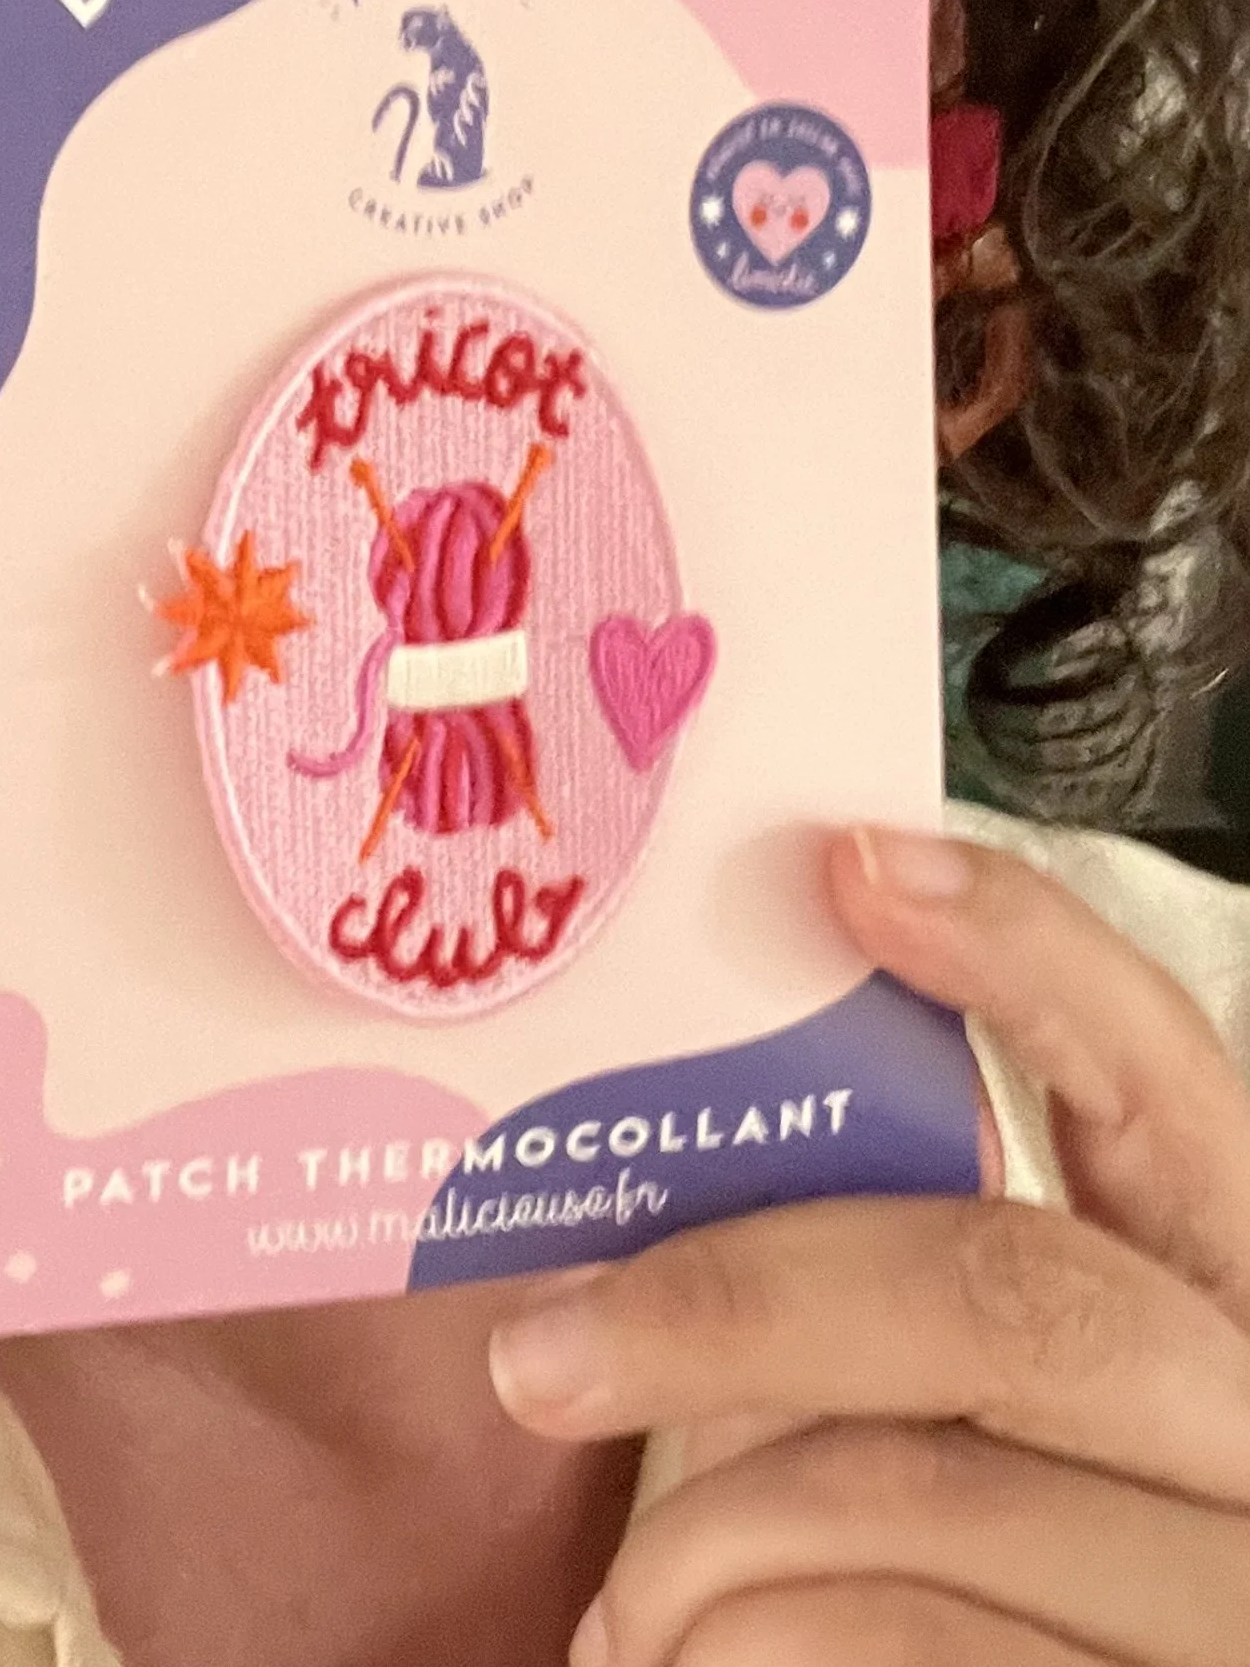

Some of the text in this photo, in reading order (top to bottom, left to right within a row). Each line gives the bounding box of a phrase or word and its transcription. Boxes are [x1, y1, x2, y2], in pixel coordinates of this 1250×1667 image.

[348, 186, 466, 236] CREATIVE
[295, 306, 587, 471] tricot
[328, 864, 586, 988] club
[63, 1088, 854, 1210] PATCH THERMOCOLLANT
